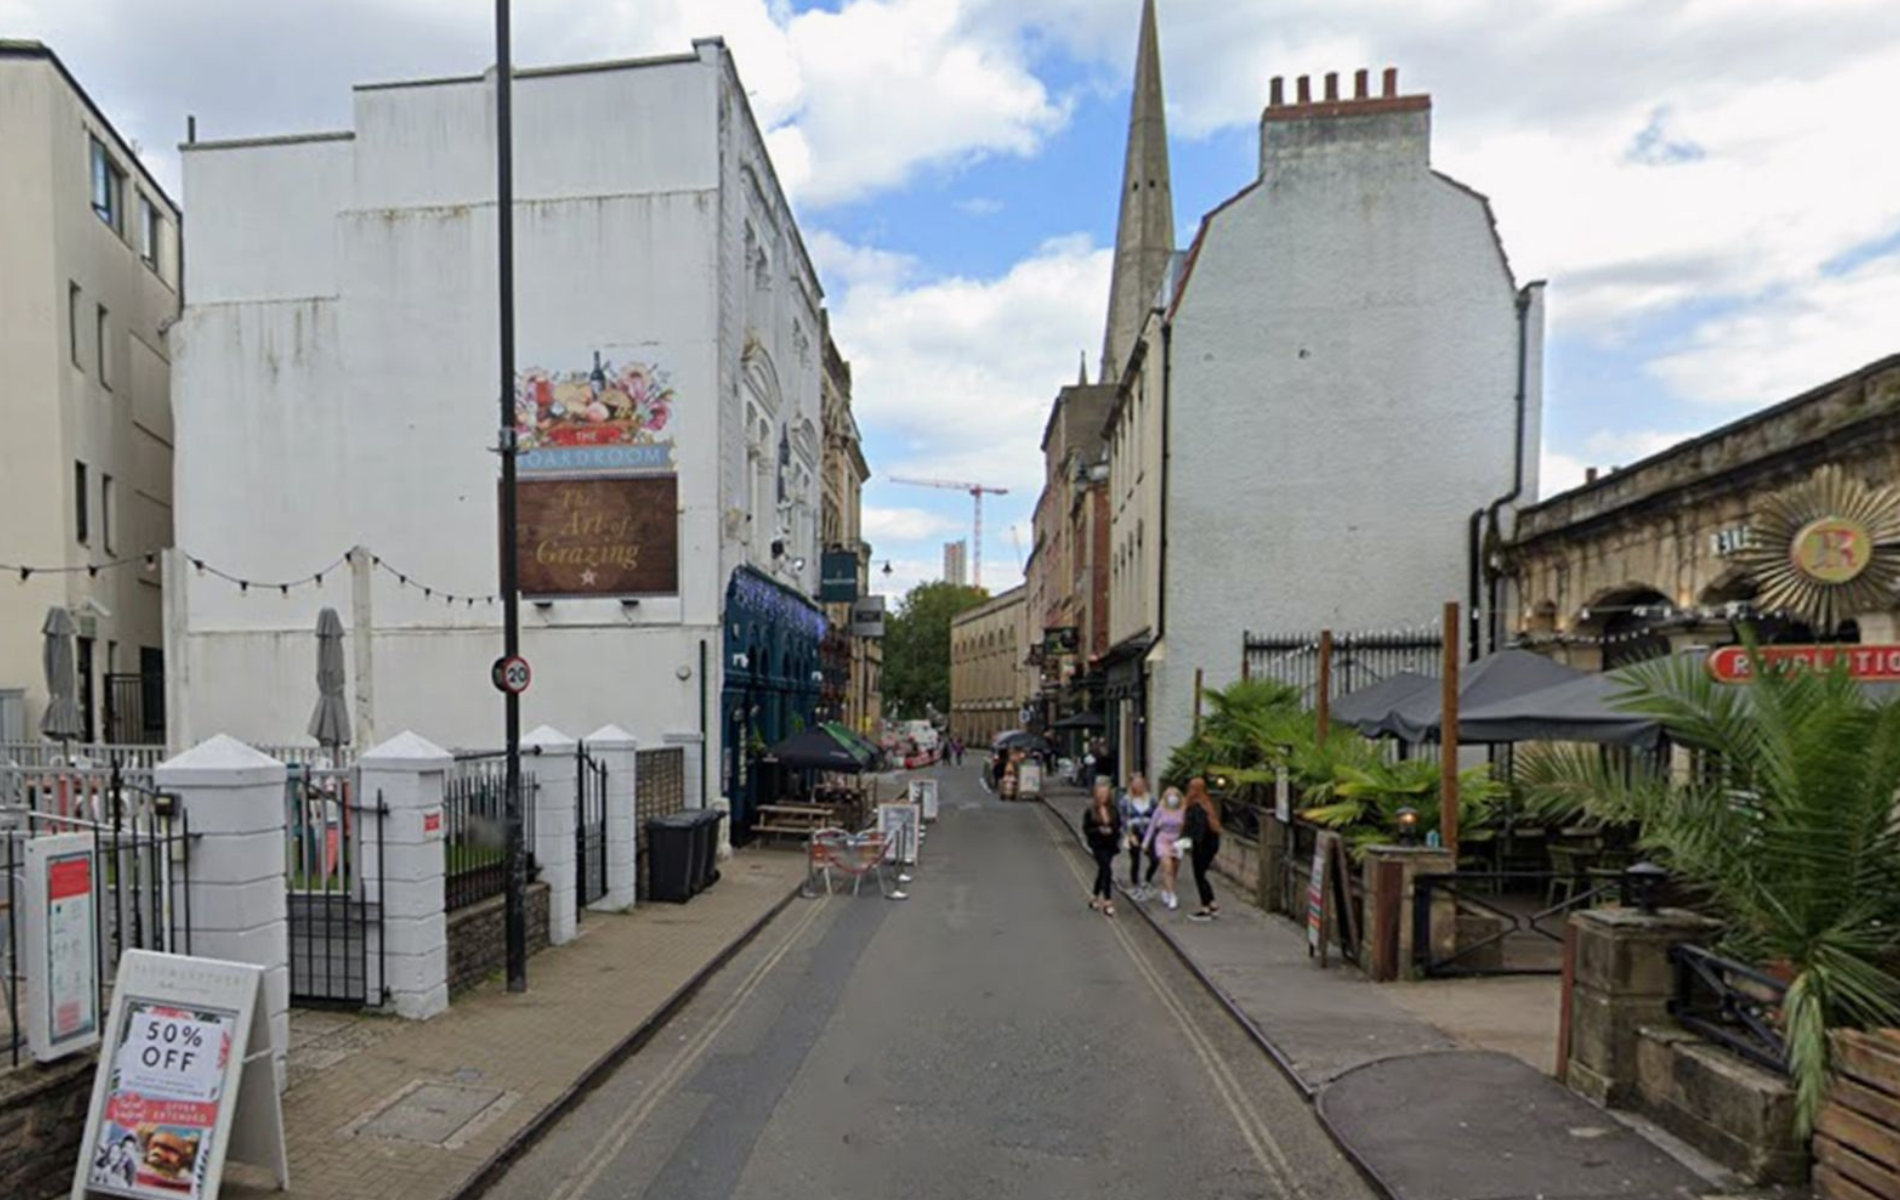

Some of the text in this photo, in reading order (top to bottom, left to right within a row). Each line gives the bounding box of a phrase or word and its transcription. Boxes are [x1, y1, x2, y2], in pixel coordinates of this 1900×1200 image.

[576, 431, 598, 441] THE
[560, 511, 631, 536] Art of
[536, 540, 641, 570] Grazing
[507, 667, 526, 682] 20
[146, 1021, 203, 1047] 50%
[142, 1046, 195, 1072] OFF
